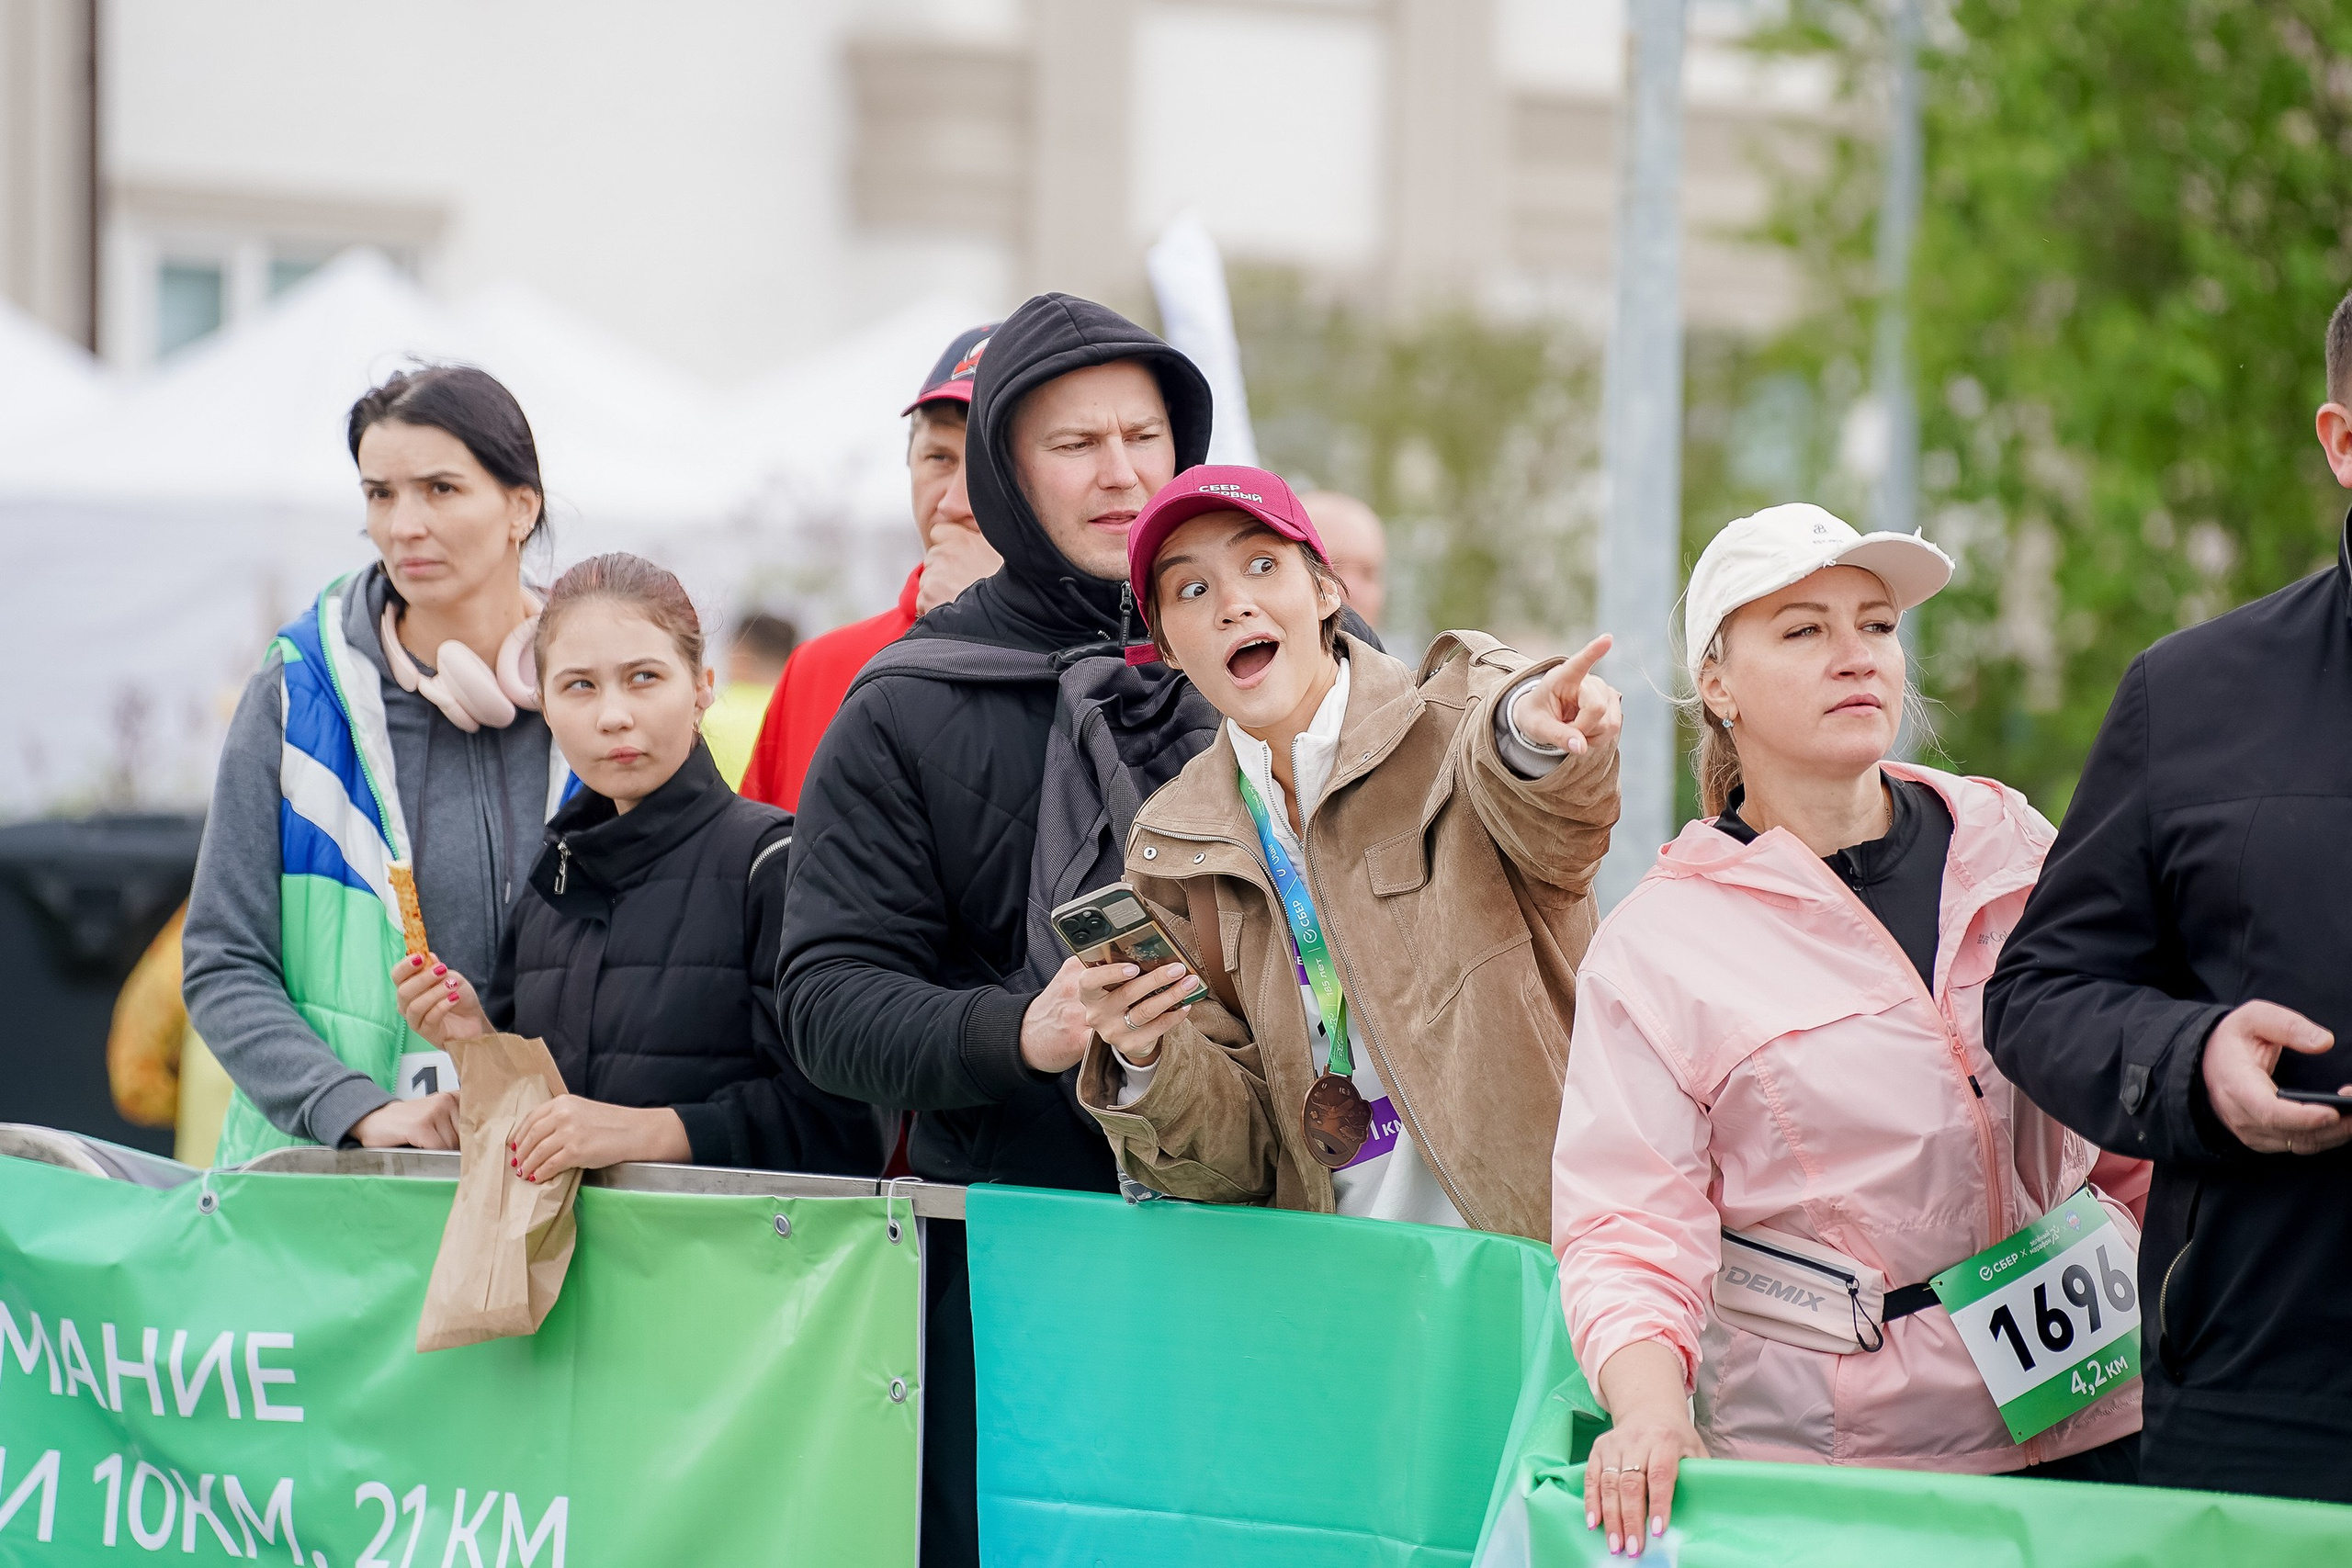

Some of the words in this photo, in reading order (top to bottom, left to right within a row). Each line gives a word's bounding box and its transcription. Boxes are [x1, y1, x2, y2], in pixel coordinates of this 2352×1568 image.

[1198, 484, 1241, 492] СБЕР
[1292, 900, 1310, 927] СБЕР
[1993, 1253, 2018, 1273] СБЕР
[1724, 1266, 1826, 1312] DEMIX
[1988, 1244, 2136, 1372] 1696
[0, 1300, 304, 1422] МАНИЕ
